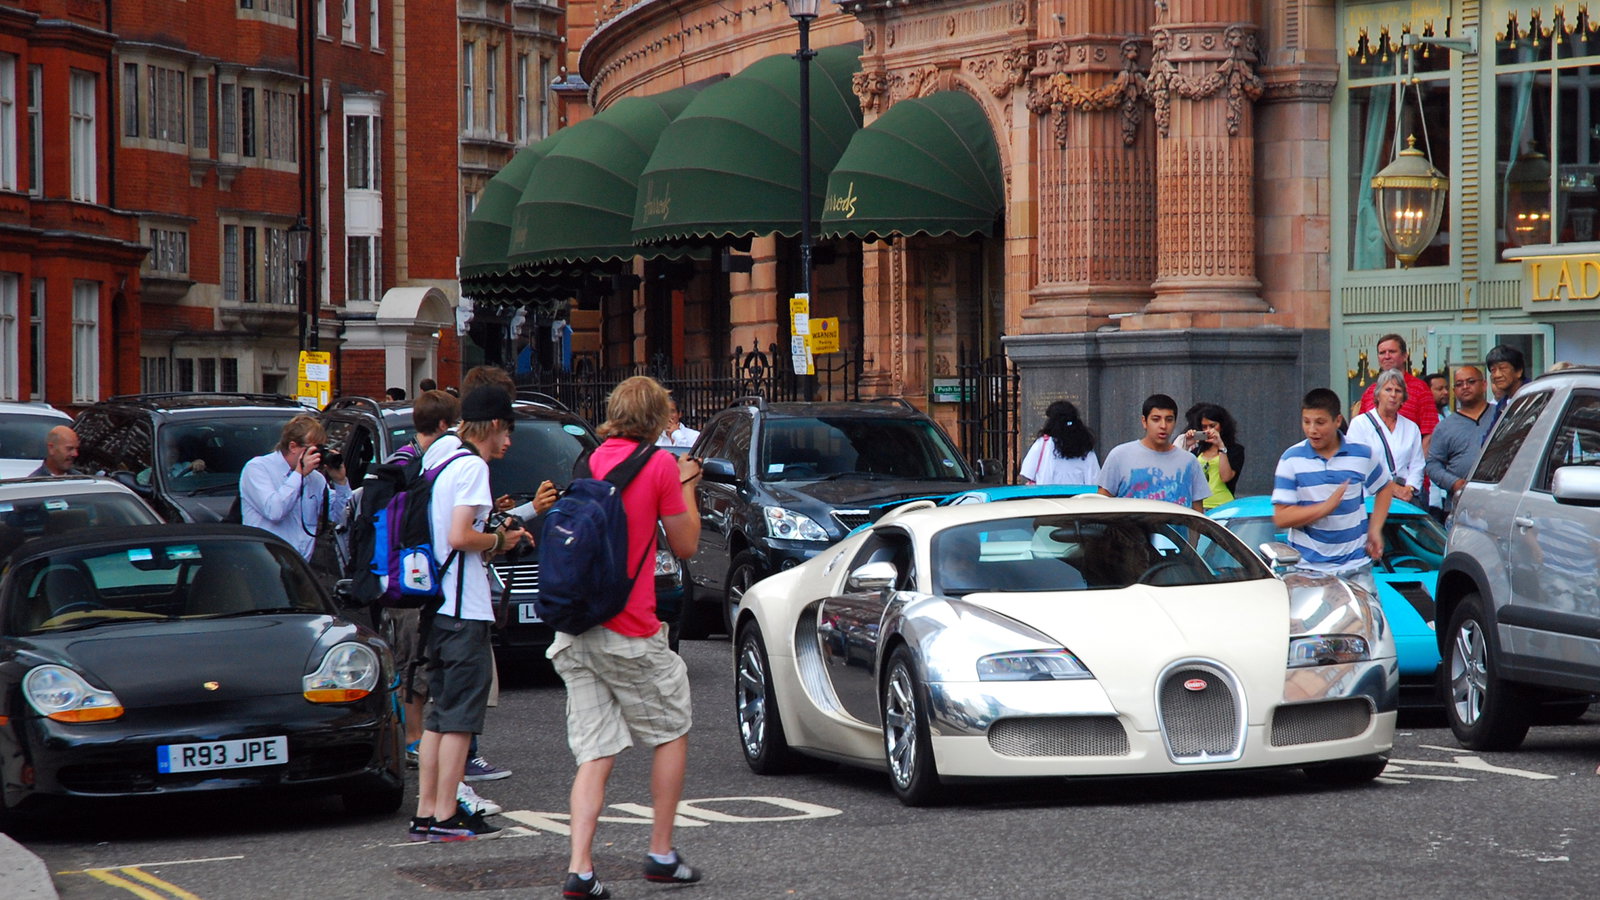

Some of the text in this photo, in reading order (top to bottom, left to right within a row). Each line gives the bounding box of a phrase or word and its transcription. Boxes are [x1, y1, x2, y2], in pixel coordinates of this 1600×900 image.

[1531, 260, 1600, 302] LAD
[183, 740, 277, 768] R93 JPE
